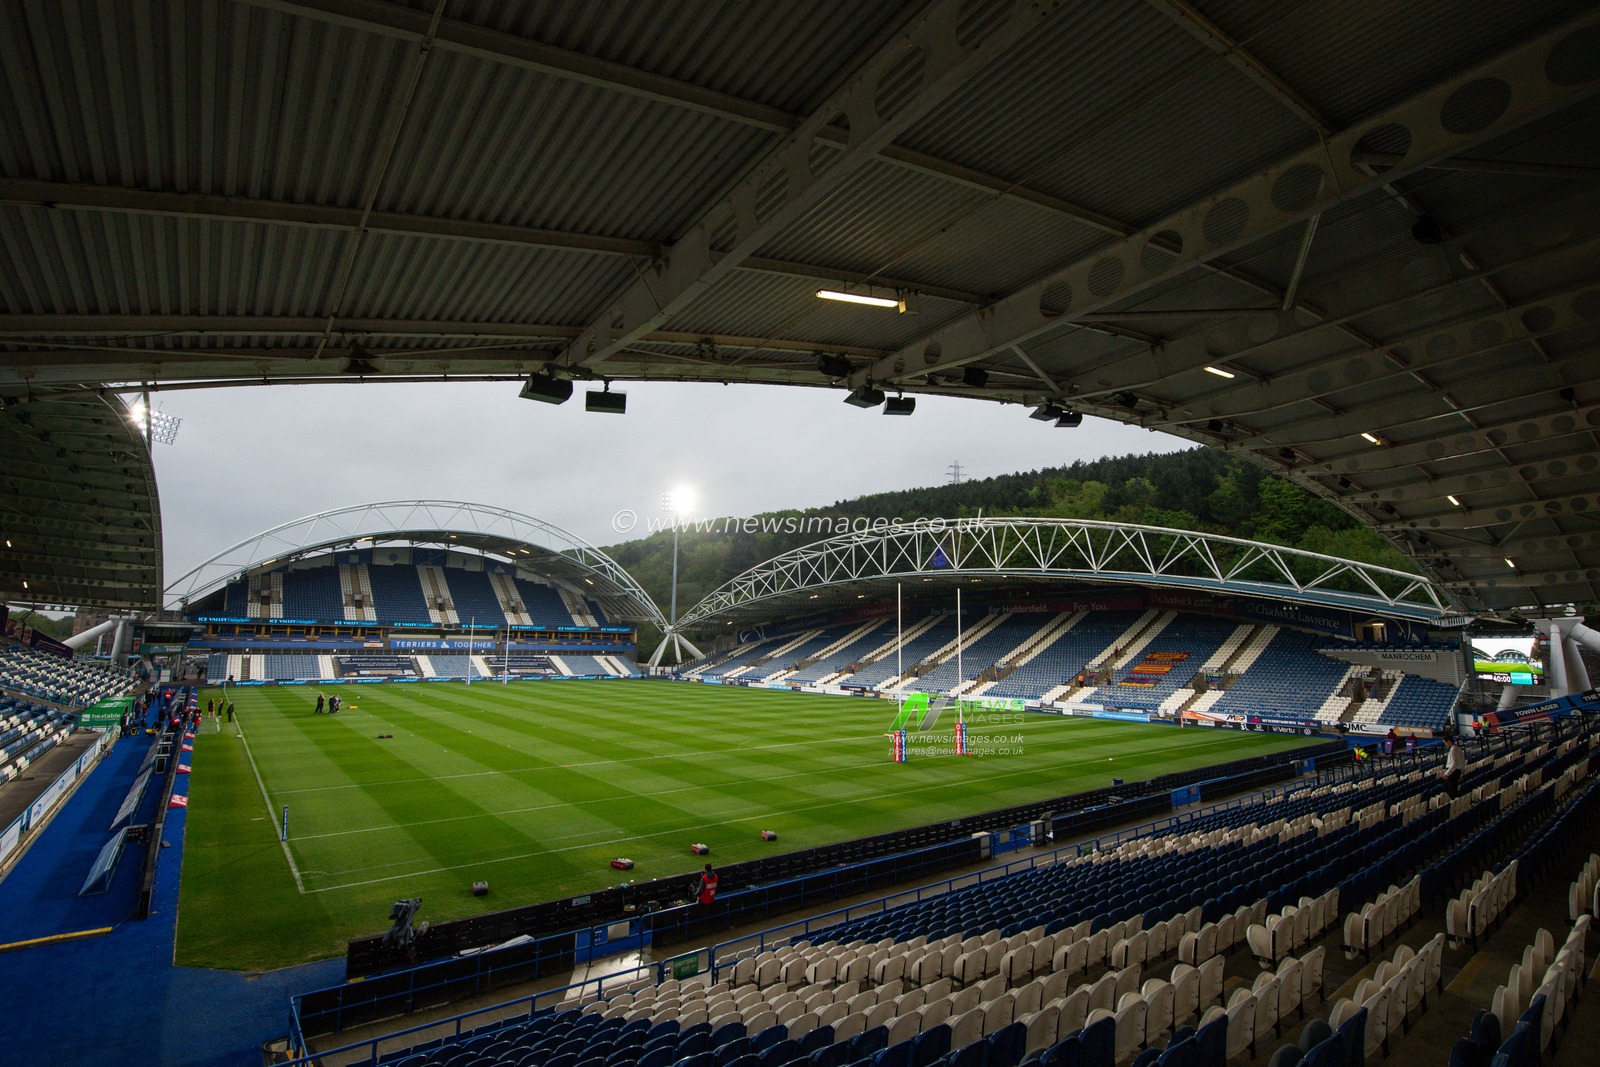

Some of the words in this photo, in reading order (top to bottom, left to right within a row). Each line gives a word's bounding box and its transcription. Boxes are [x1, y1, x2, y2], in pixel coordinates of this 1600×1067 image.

[988, 605, 1000, 614] For
[1002, 604, 1048, 613] Huddersfield.
[1073, 602, 1088, 611] For
[1090, 602, 1108, 610] You.
[1256, 603, 1296, 620] Chadwick
[1298, 611, 1340, 628] Lawrence
[1381, 653, 1432, 661] MANROCHEM
[1514, 708, 1536, 717] TOWN
[1536, 703, 1559, 713] LAGER
[1582, 693, 1598, 702] THE
[1278, 726, 1295, 734] Vertu
